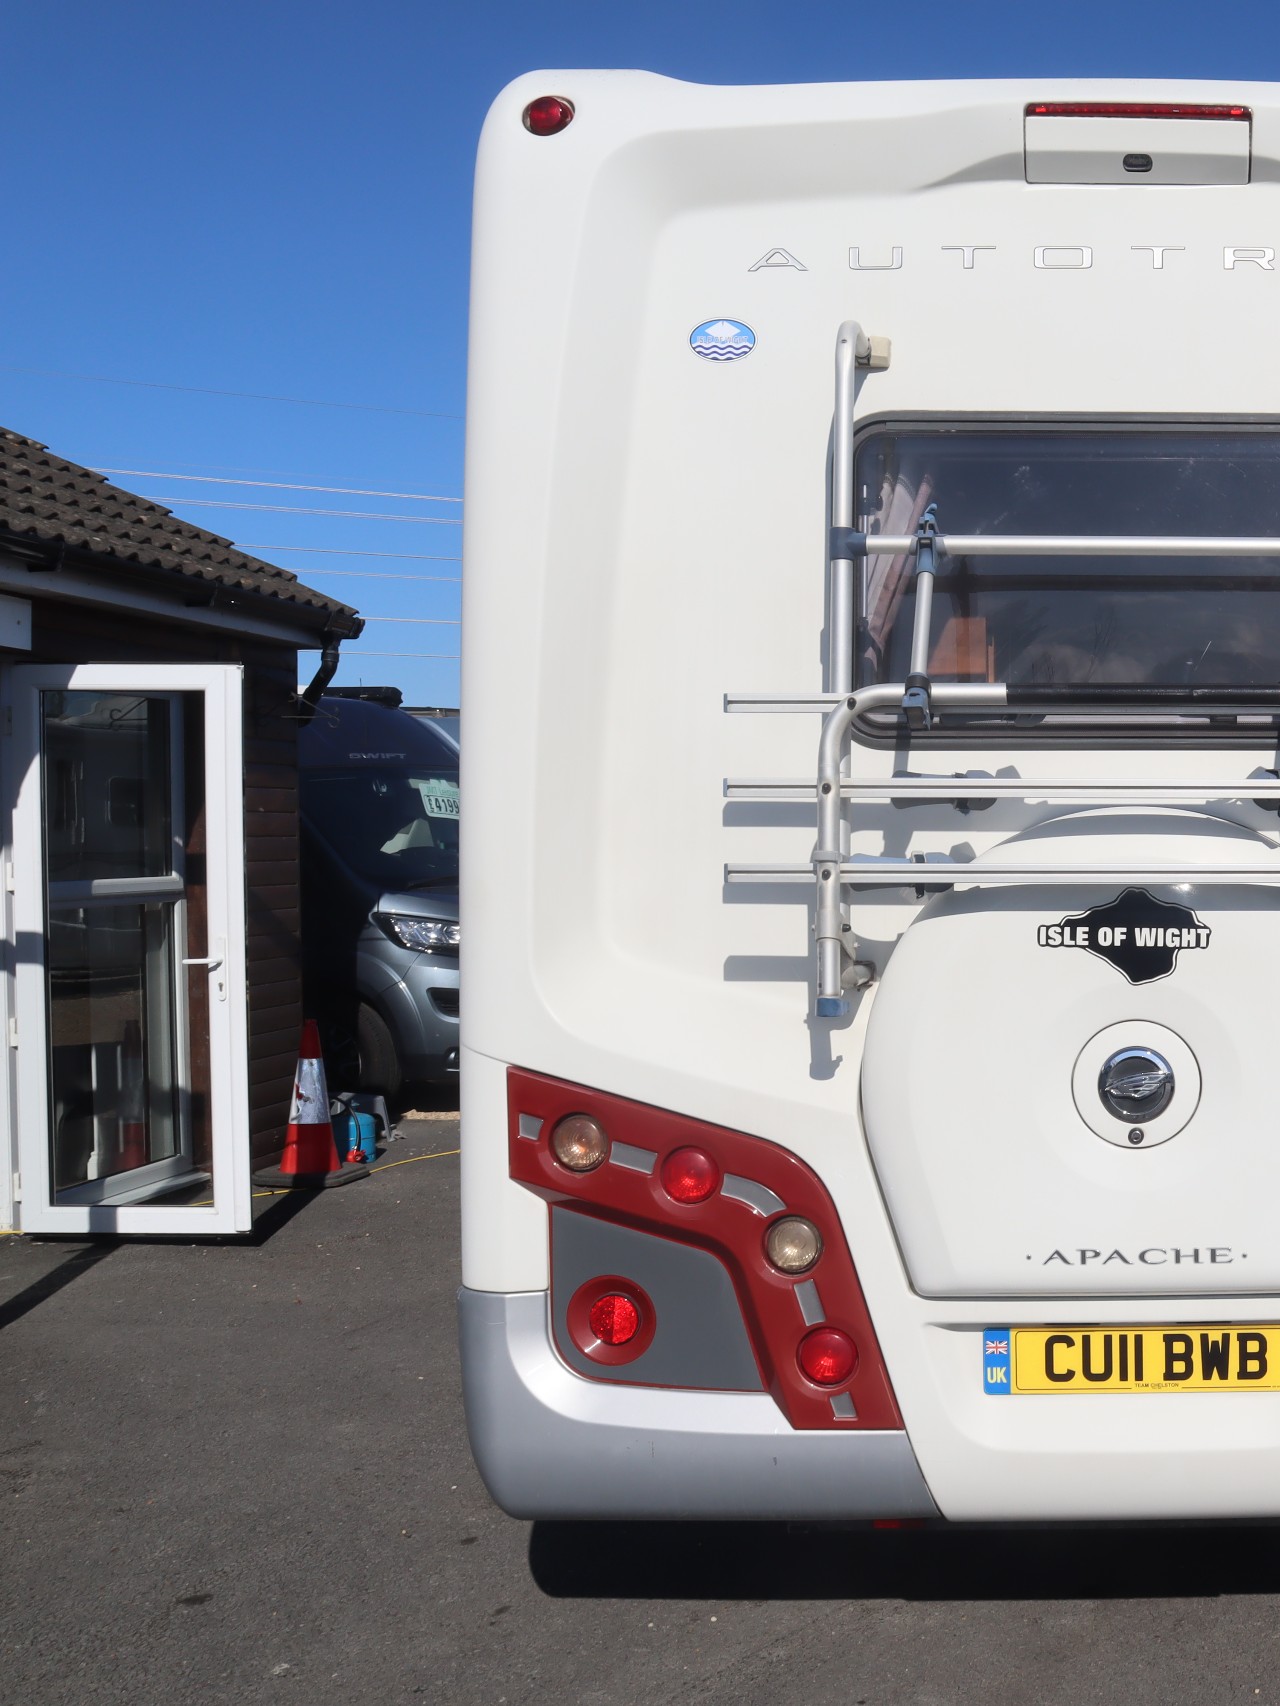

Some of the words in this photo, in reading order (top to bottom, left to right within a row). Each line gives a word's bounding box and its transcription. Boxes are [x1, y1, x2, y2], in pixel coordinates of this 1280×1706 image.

[428, 797, 460, 814] £4199
[1039, 926, 1090, 946] ISLE
[1097, 927, 1127, 947] OF
[1134, 927, 1210, 948] WIGHT
[1042, 1248, 1235, 1265] APACHE
[1044, 1333, 1144, 1383] CU11
[1162, 1331, 1268, 1381] BWB
[986, 1366, 1007, 1384] UK
